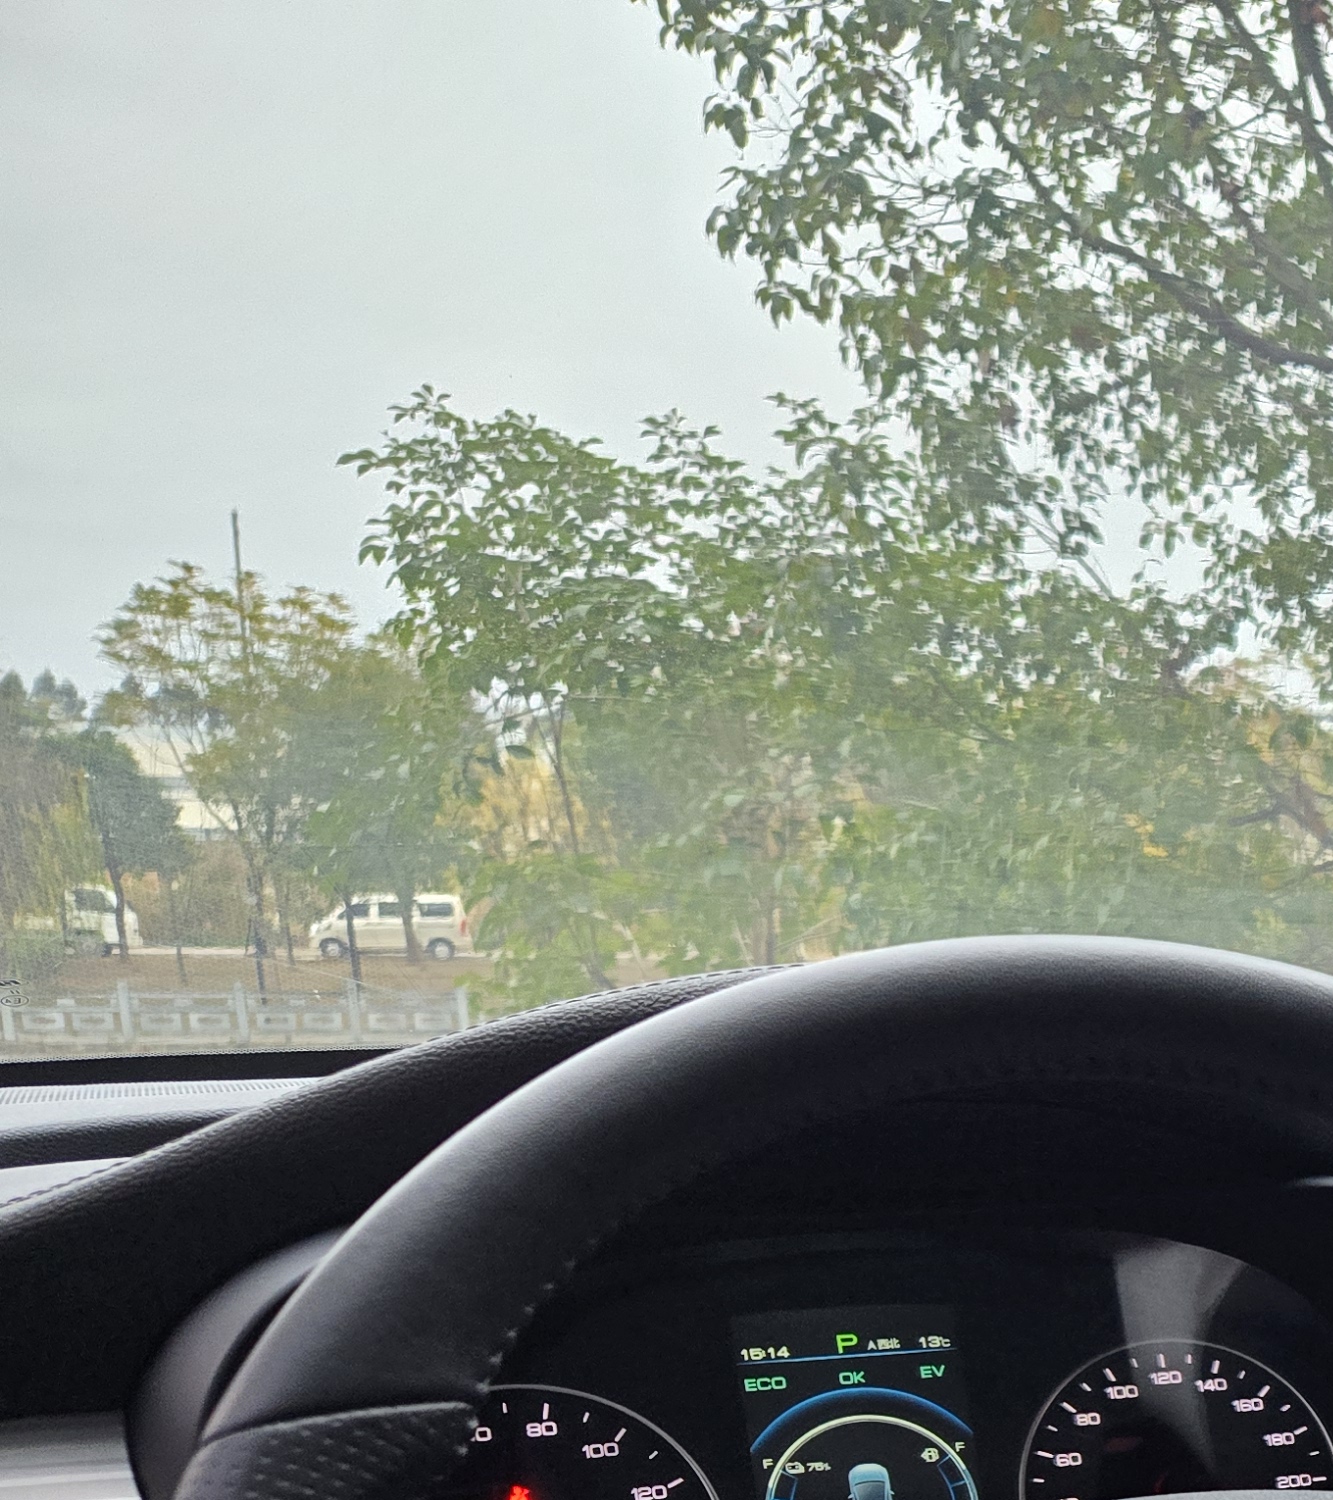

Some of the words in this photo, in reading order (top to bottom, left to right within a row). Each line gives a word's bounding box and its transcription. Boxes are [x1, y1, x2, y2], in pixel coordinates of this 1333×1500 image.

[836, 1334, 858, 1354] P
[741, 1346, 790, 1361] 15:14
[839, 1371, 865, 1385] OK
[920, 1364, 945, 1379] EV
[1148, 1370, 1182, 1385] 120
[744, 1376, 787, 1392] ECO
[1195, 1378, 1228, 1393] 140
[1104, 1385, 1139, 1400] 100
[1231, 1397, 1264, 1412] 160
[1074, 1412, 1101, 1426] 80
[526, 1421, 558, 1437] 80
[1263, 1432, 1295, 1446] 180
[582, 1442, 619, 1459] 100
[955, 1442, 966, 1452] F
[763, 1458, 773, 1470] F
[1053, 1452, 1082, 1467] 60
[1275, 1473, 1312, 1488] 200
[630, 1485, 667, 1500] 120
